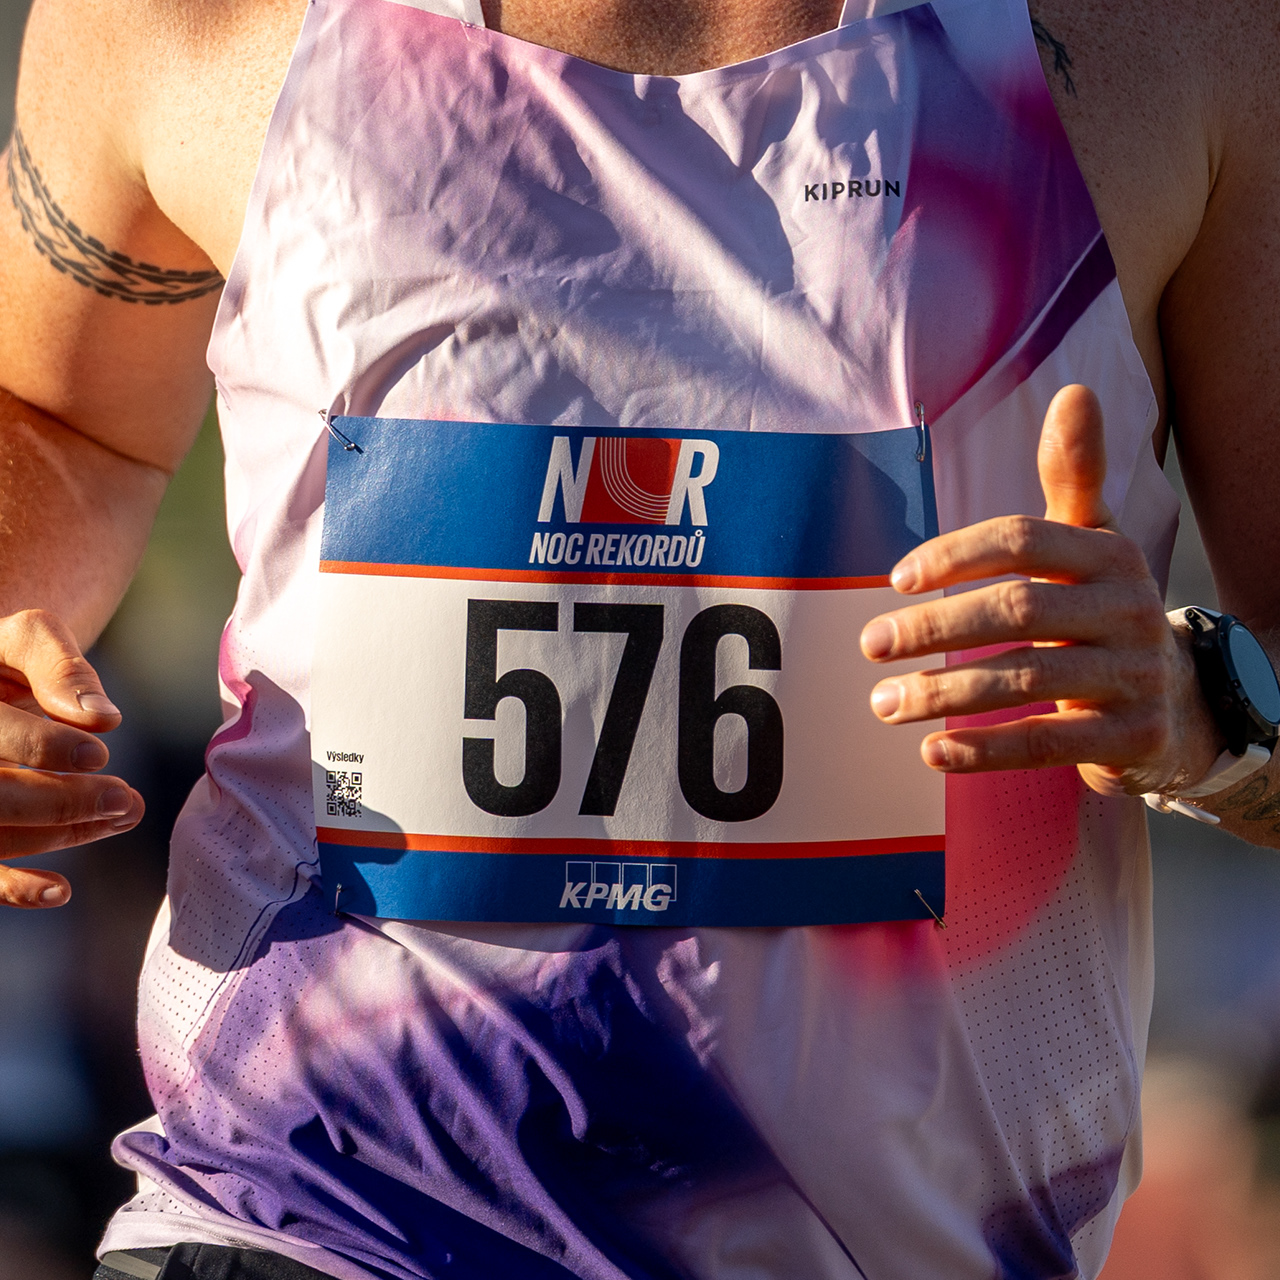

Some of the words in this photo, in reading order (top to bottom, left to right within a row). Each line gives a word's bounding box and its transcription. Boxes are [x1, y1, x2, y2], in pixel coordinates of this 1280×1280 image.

[804, 179, 901, 202] KIPRUN
[528, 532, 584, 565] NOC
[584, 529, 706, 568] REKORDŮ
[461, 598, 785, 823] 576
[326, 750, 365, 764] Výsledky
[558, 881, 673, 912] KPMG
